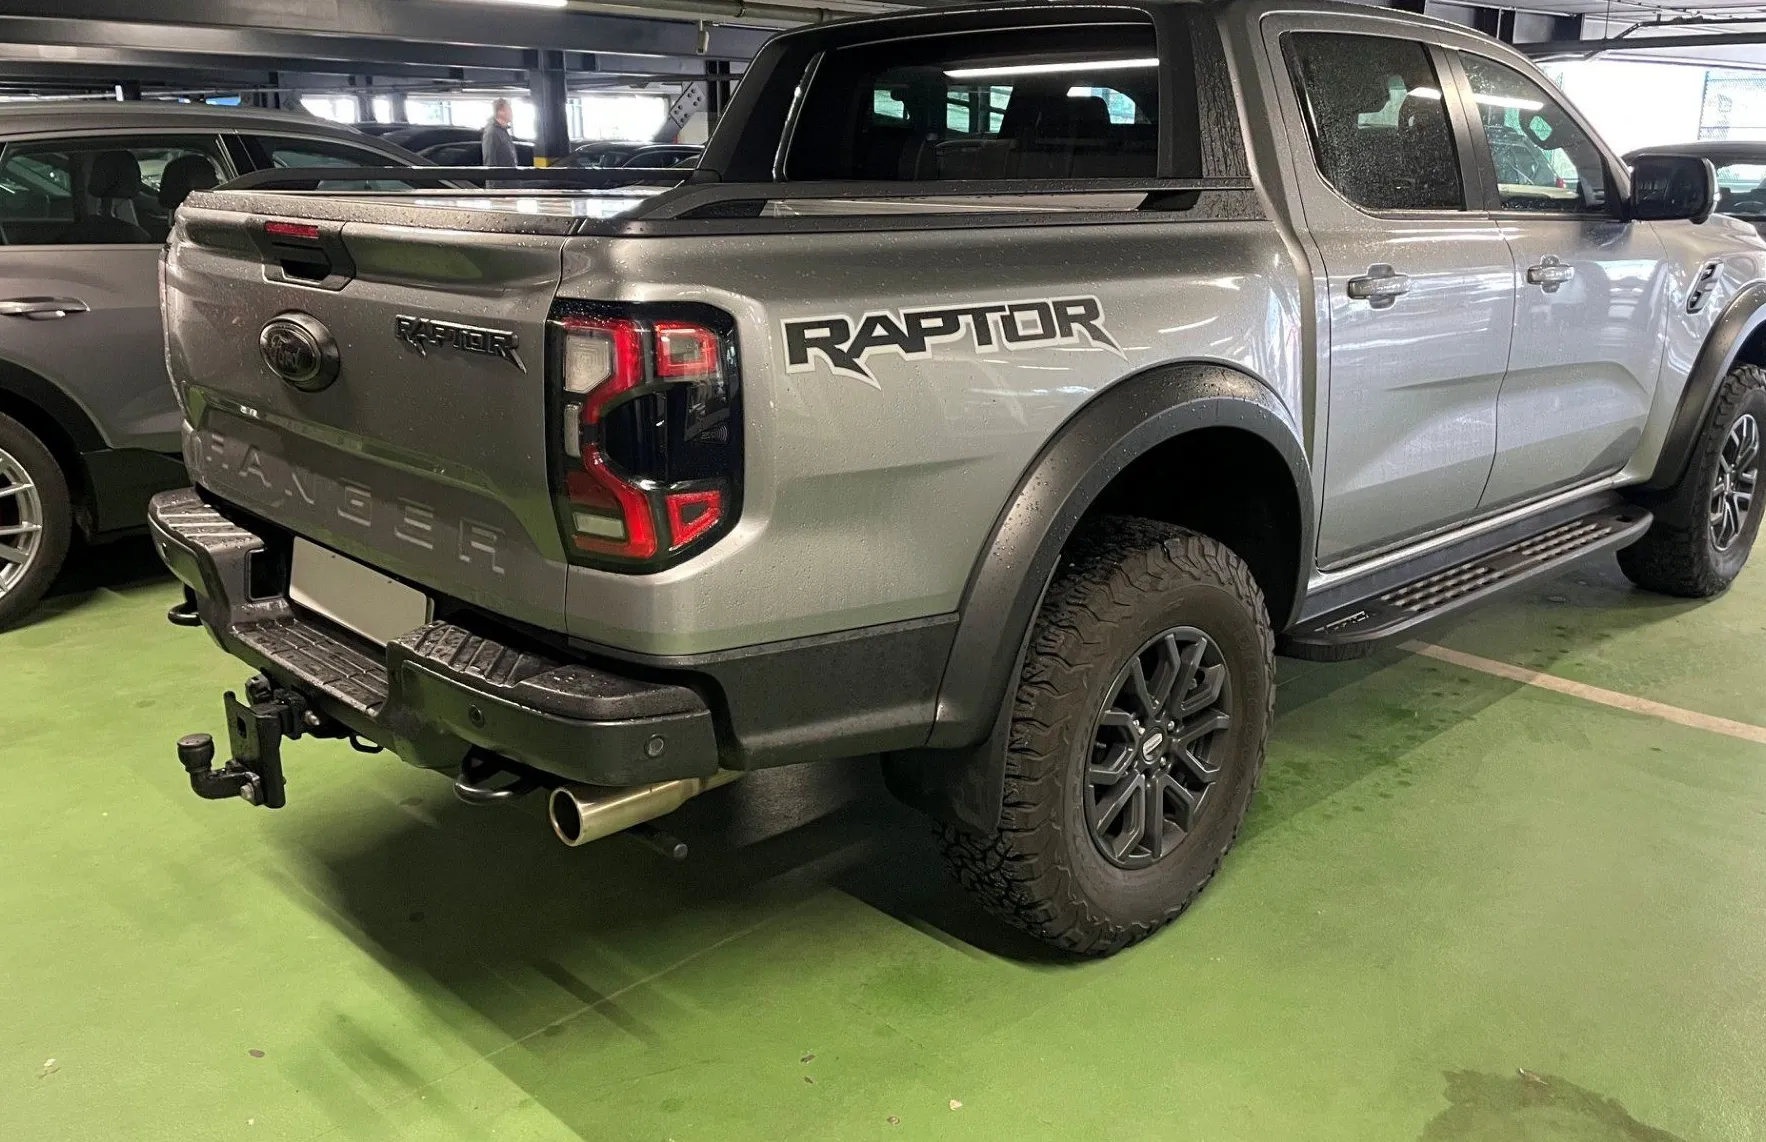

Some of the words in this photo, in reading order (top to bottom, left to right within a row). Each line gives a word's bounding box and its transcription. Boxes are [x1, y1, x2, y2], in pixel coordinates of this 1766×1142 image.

[395, 314, 527, 374] RAPTOR
[781, 295, 1129, 390] RAPTOR
[203, 431, 505, 575] RANGER
